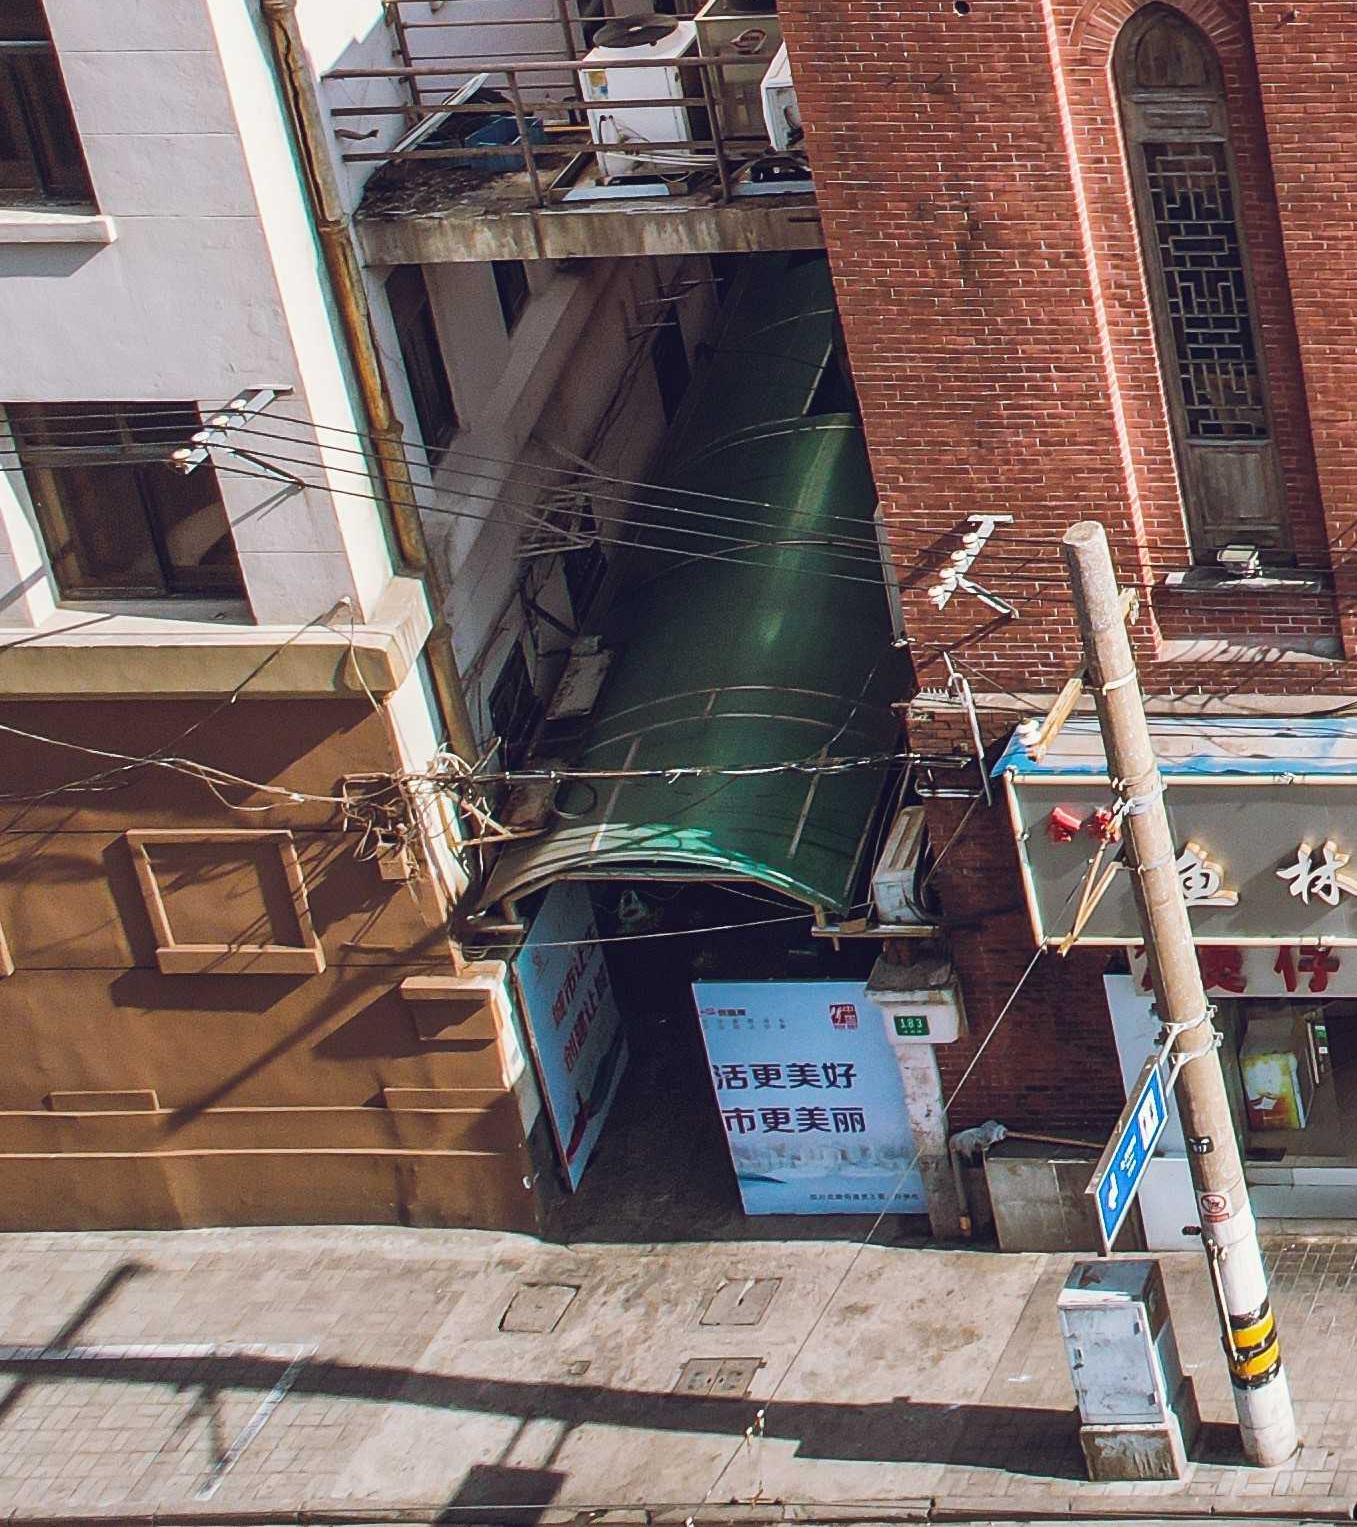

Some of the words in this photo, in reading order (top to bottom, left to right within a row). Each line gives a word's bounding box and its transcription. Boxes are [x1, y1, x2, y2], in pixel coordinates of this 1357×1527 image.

[900, 1018, 923, 1029] 183
[713, 1061, 858, 1091] 活更美好
[722, 1106, 867, 1135] 市更美丽
